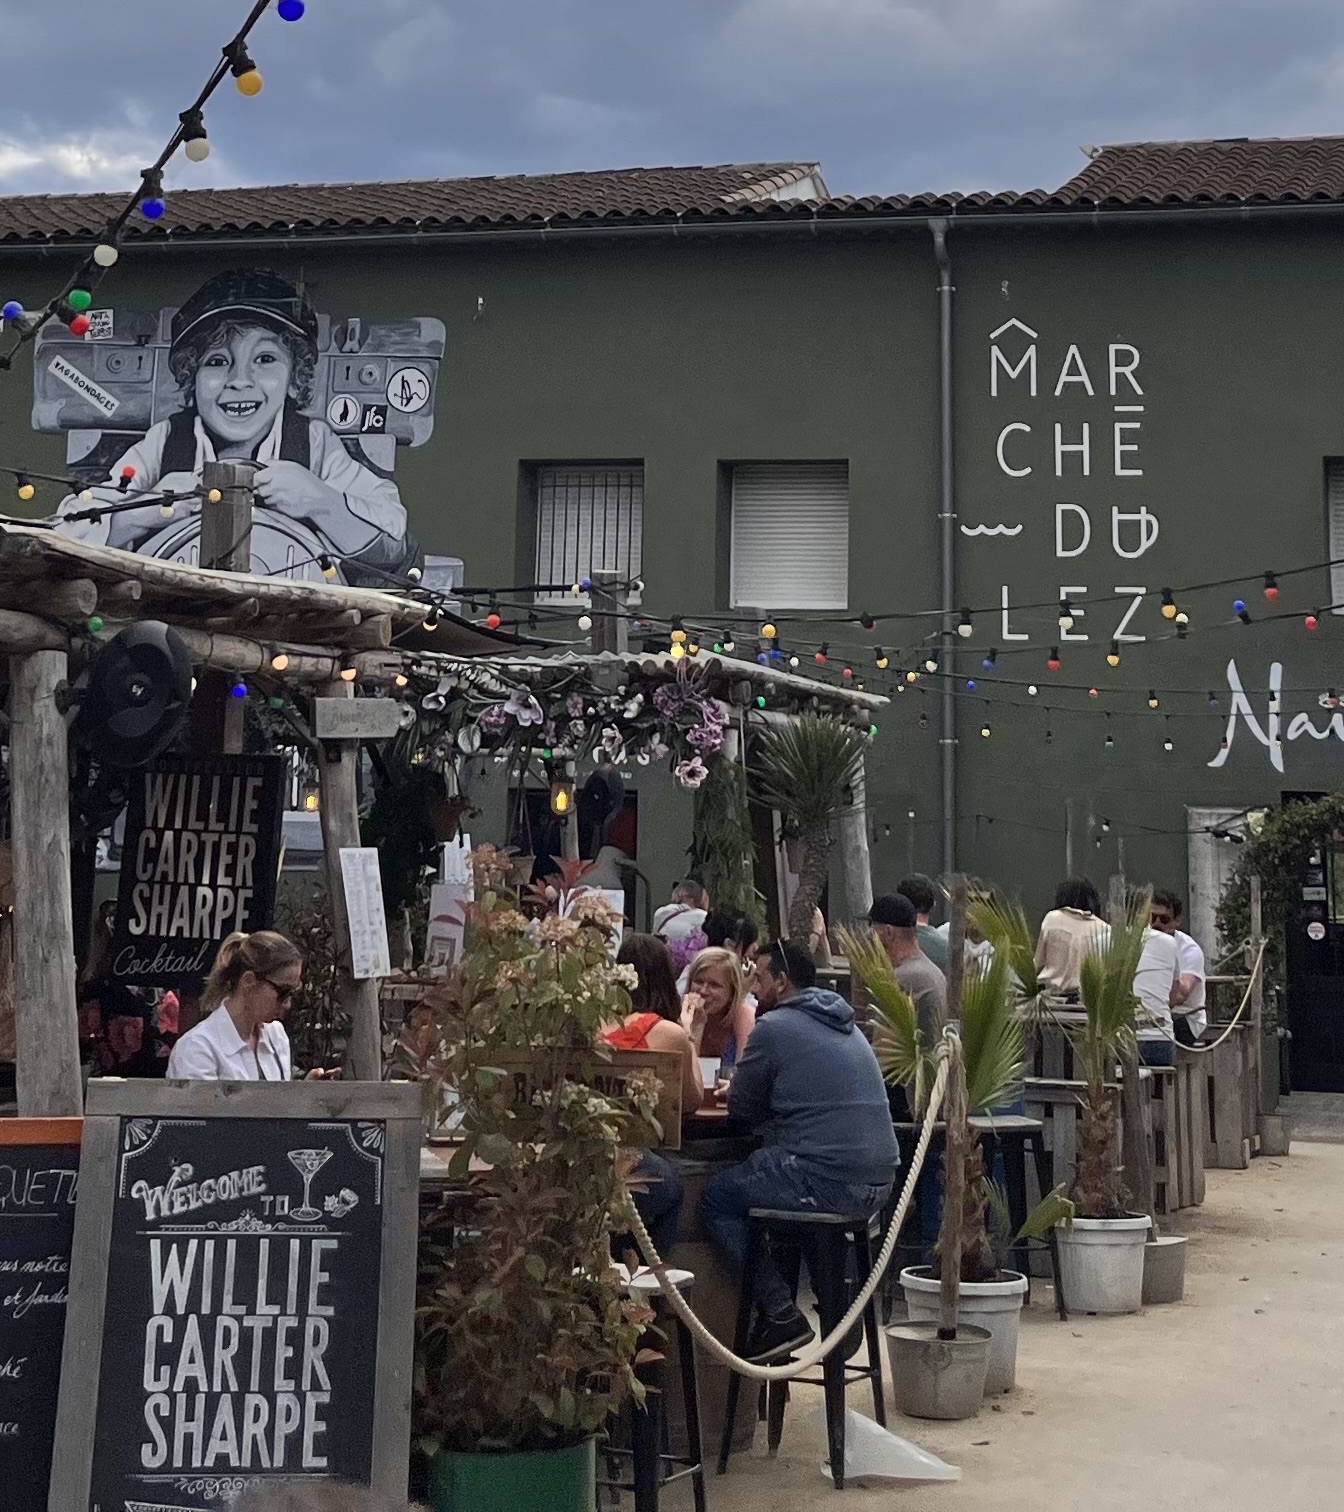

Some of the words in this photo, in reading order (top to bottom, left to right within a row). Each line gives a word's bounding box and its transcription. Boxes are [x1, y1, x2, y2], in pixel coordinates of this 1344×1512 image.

[53, 361, 116, 411] VAGABONDAGES
[1002, 585, 1146, 641] LEZ
[144, 772, 264, 833] WILLIE
[135, 829, 257, 888] CARTER
[131, 1162, 268, 1221] WELCOME
[260, 1194, 290, 1216] TO
[20, 1255, 69, 1273] notre
[149, 1238, 339, 1316] WILLIE
[4, 1287, 24, 1306] et
[143, 1313, 332, 1393] CARTER
[140, 1390, 332, 1468] SHARPE
